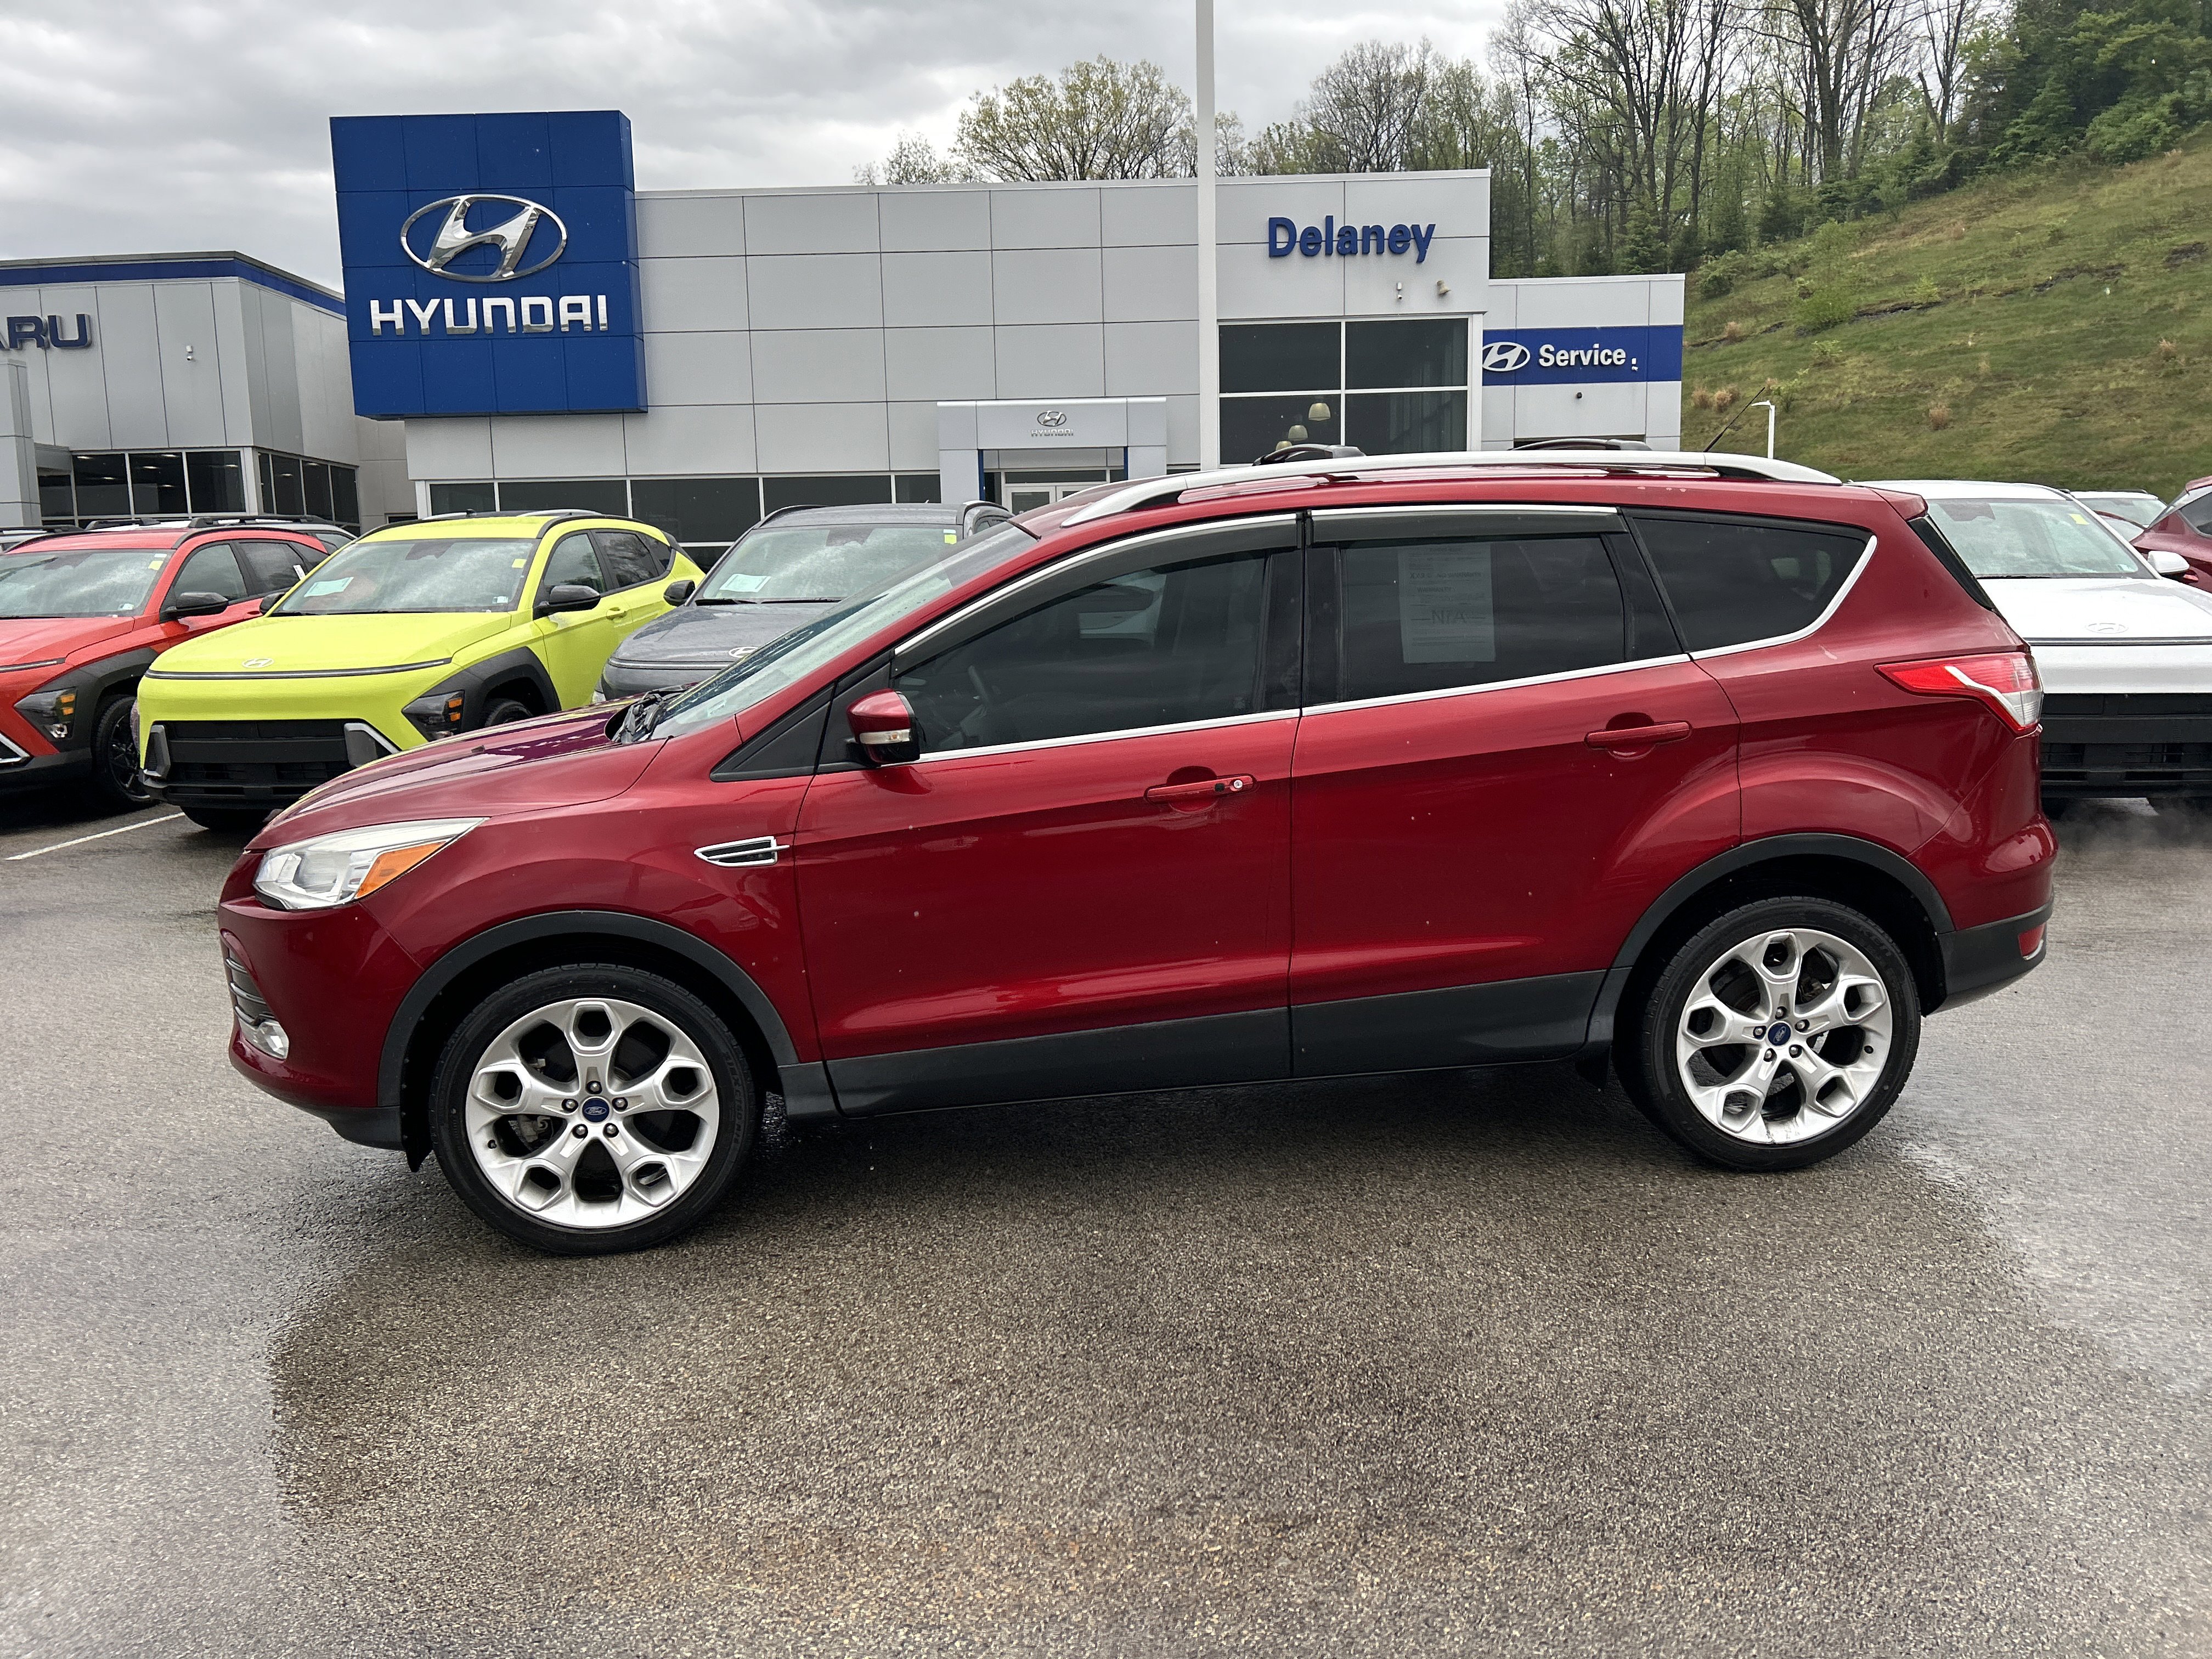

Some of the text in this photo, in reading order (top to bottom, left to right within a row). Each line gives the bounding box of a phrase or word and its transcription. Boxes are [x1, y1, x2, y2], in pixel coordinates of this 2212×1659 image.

[1268, 215, 1436, 263] Delaney
[0, 313, 91, 351] RU
[370, 295, 608, 336] HYUNDAI
[1538, 343, 1627, 367] Service
[1031, 428, 1074, 437] HYUNDAI
